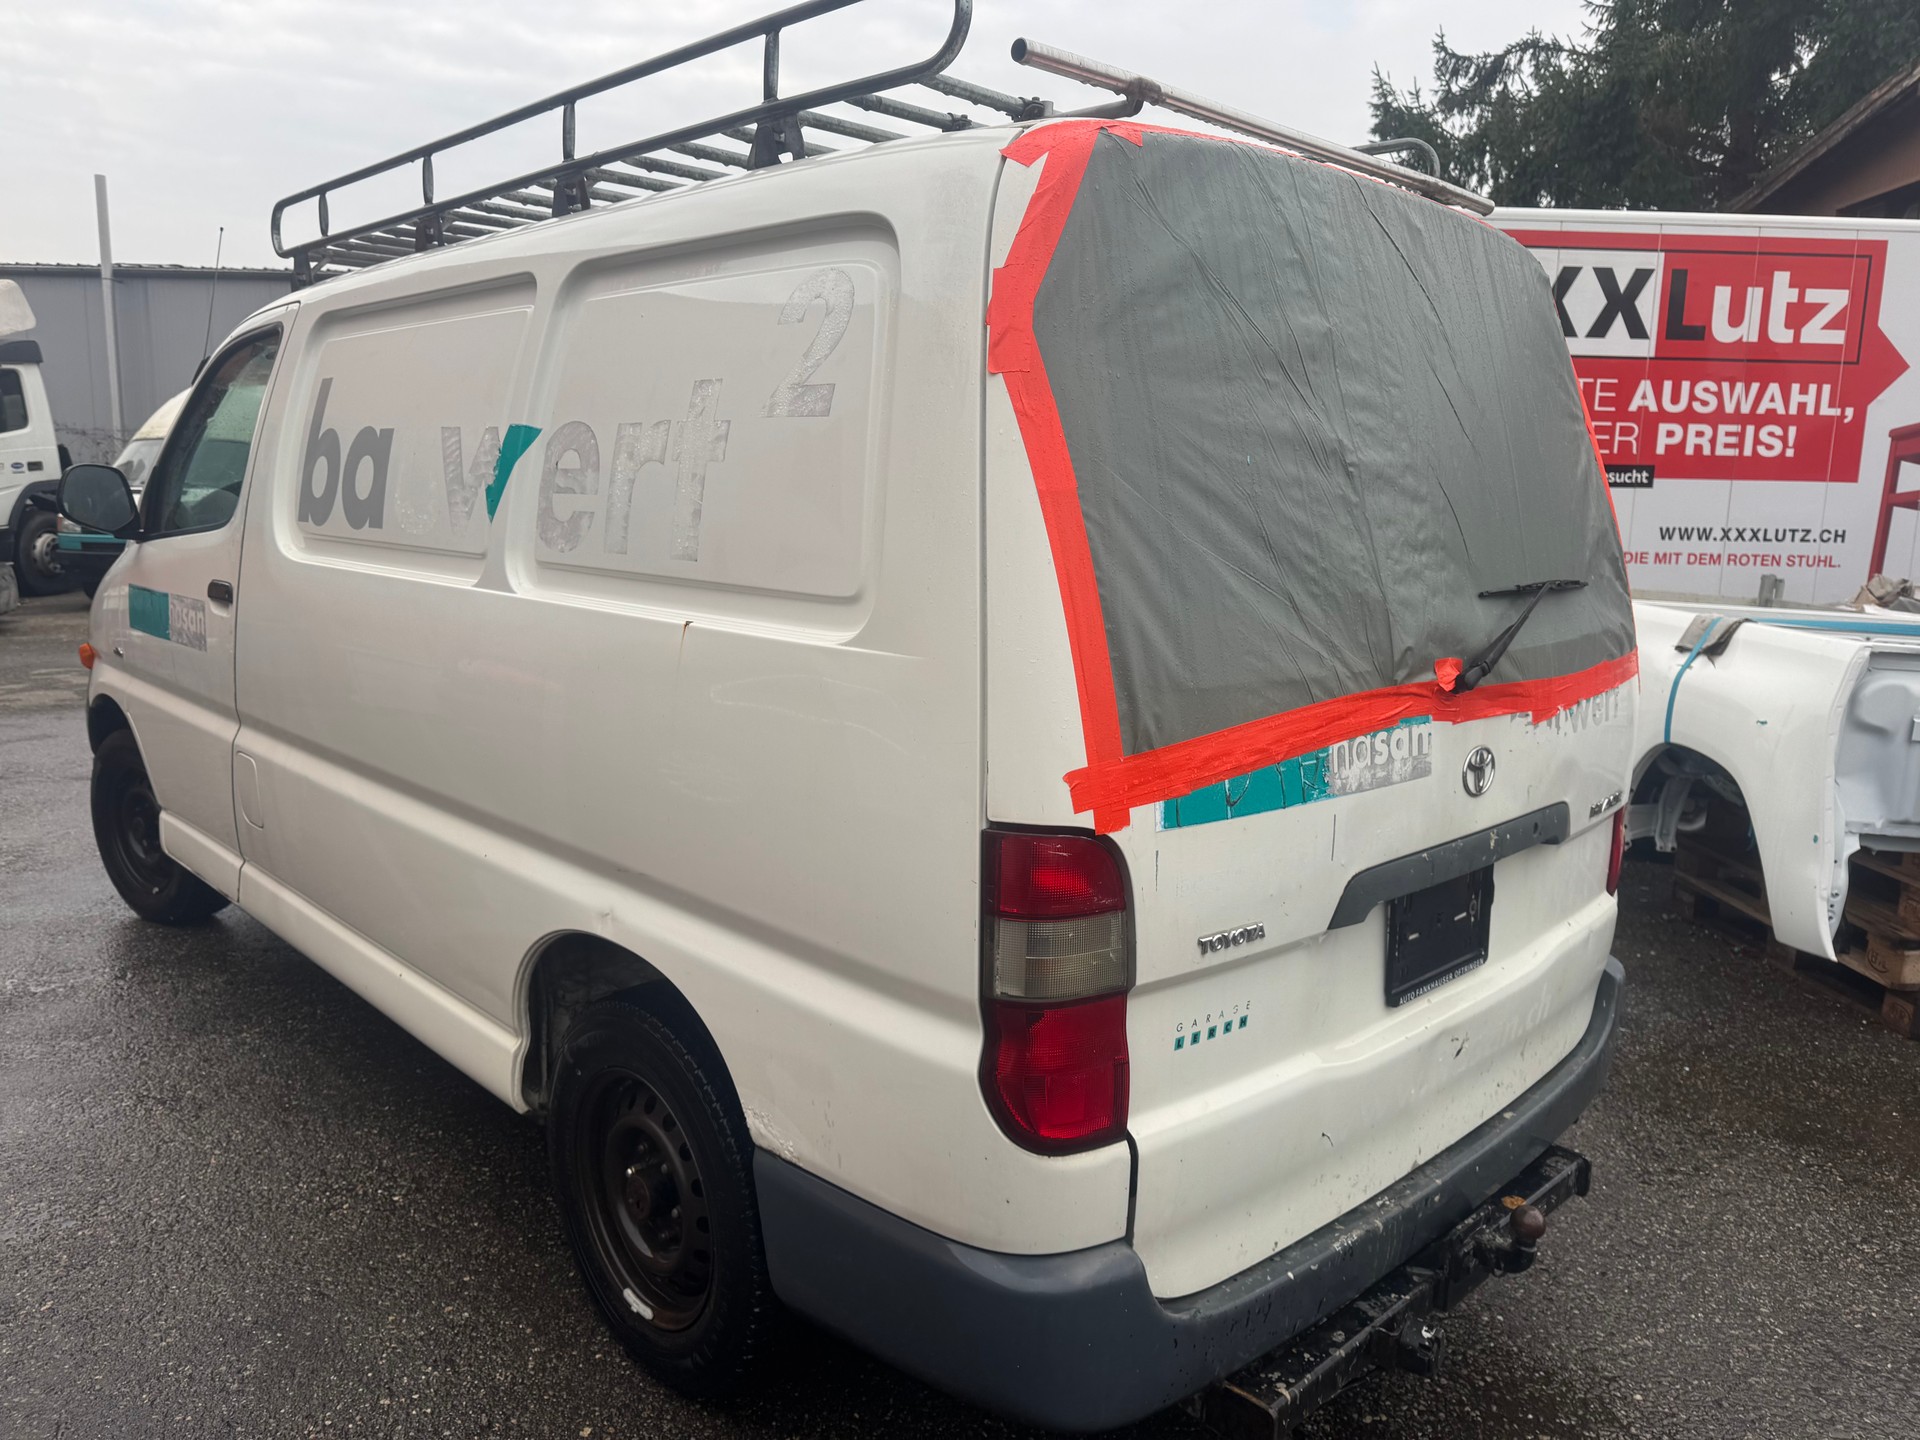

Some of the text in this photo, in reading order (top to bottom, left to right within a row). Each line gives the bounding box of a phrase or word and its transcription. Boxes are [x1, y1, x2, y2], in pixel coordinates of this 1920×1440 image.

[1627, 379, 1854, 423] AUSWAHL,
[1655, 423, 1798, 458] PREIS!
[1605, 469, 1649, 483] sucht
[1659, 526, 1847, 544] WWW.XXXLUTZ.CH
[1624, 551, 1842, 568] DIE MIT DEM ROTEN STUHL.
[1197, 921, 1266, 955] TOYOTA
[1398, 958, 1485, 1006] AUTO FANKHAUSER OFTRINGEN
[1174, 1015, 1248, 1051] LERCH
[1175, 1000, 1251, 1033] GARAGE
